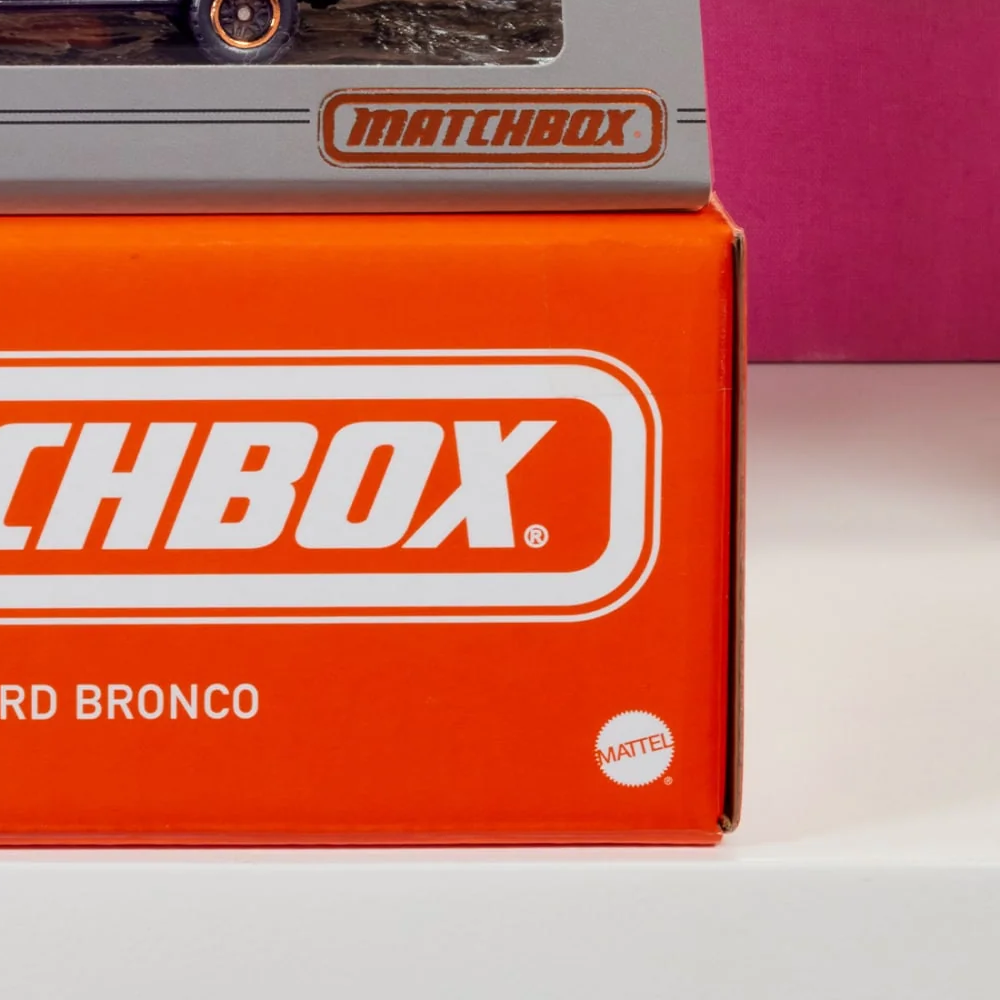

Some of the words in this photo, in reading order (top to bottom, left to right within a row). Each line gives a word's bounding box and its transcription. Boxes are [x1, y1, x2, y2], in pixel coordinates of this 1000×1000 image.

[346, 107, 636, 147] MATCHBOX
[75, 682, 259, 720] BRONCO
[598, 732, 673, 766] MATTEL
